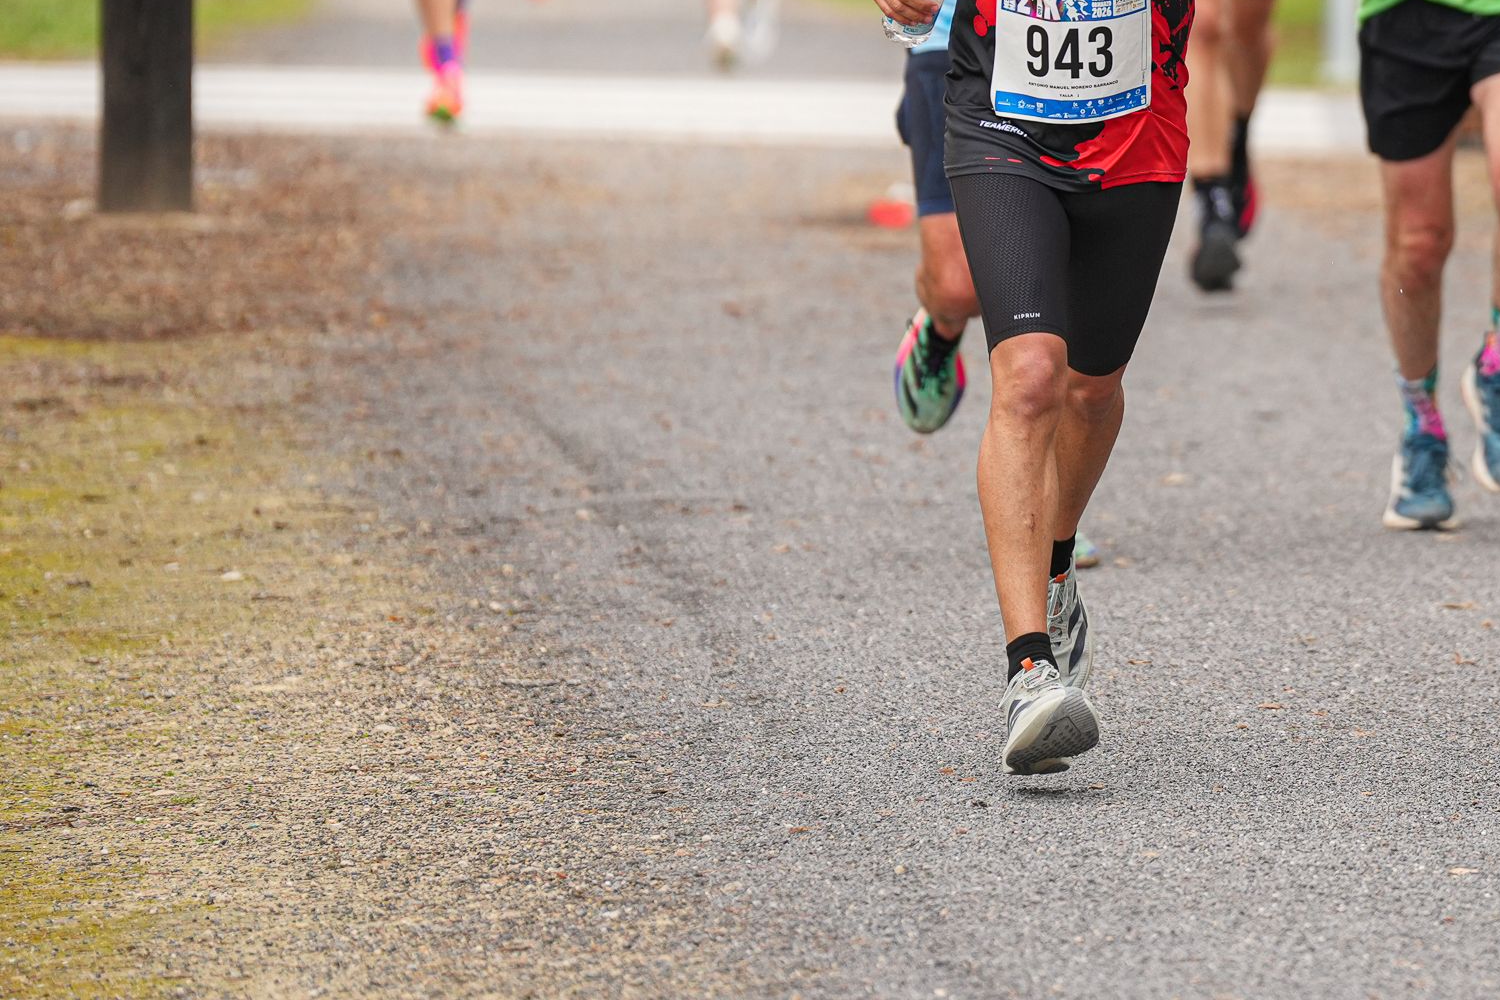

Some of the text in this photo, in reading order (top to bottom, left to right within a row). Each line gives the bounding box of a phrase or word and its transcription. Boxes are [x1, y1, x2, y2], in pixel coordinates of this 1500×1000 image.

[1091, 7, 1112, 18] 2026
[1026, 24, 1113, 79] 943
[1094, 79, 1119, 88] BARRANCO
[1013, 312, 1041, 320] KIPRUN
